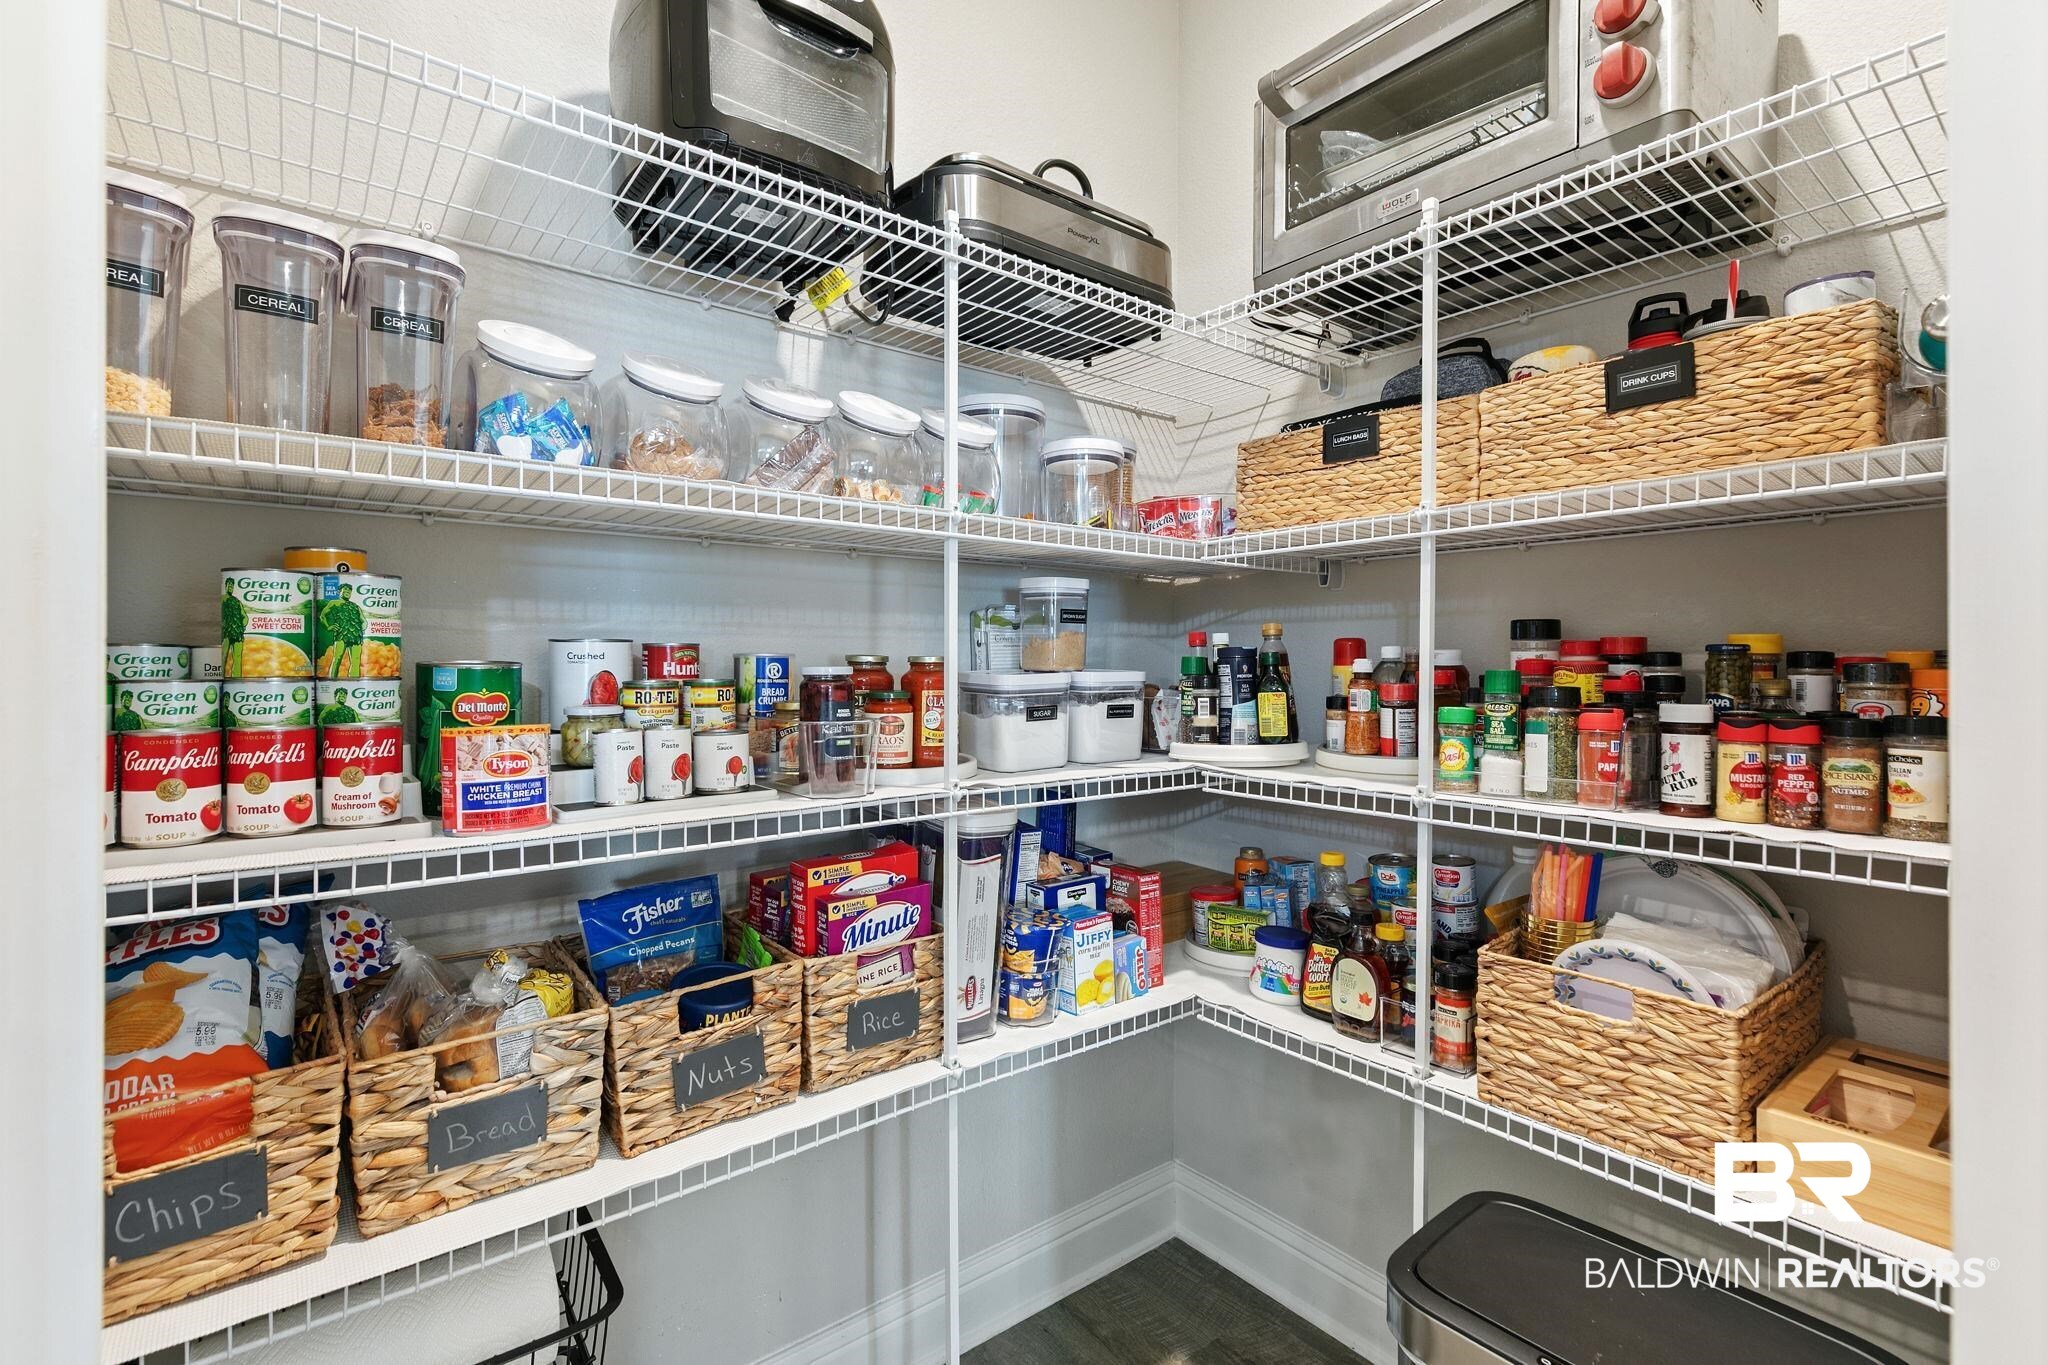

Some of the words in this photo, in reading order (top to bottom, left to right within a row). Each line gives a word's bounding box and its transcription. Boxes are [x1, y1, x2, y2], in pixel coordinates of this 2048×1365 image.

[1383, 193, 1412, 211] WOLF
[1067, 227, 1100, 245] PowerXL
[106, 267, 149, 286] REAL
[247, 294, 306, 315] CEREAL
[383, 316, 433, 334] CEREAL
[1622, 375, 1649, 388] DRINK
[1650, 370, 1676, 382] CUPS
[1334, 435, 1352, 444] LUNCH
[1352, 432, 1368, 440] BAGS
[237, 577, 290, 589] Green
[243, 590, 292, 602] Giant
[356, 584, 398, 596] Green
[363, 596, 398, 608] Giant
[114, 653, 171, 666] Green
[567, 652, 605, 661] Crushed
[121, 665, 173, 678] Giant
[204, 663, 222, 672] Dar
[137, 689, 196, 702] Green
[233, 690, 285, 702] Green
[352, 687, 395, 699] Green
[762, 687, 785, 696] BREAD
[358, 699, 396, 711] Giant
[457, 702, 476, 712] Del
[477, 701, 507, 712] Monte
[927, 696, 945, 707] CLA
[1707, 698, 1730, 707] OYA
[144, 702, 198, 716] Giant
[238, 702, 286, 716] Giant
[1033, 710, 1051, 718] SUGAR
[472, 714, 494, 722] Quality
[780, 724, 800, 737] BETTE
[227, 742, 306, 769] Campbell's
[322, 738, 395, 763] Campbell's
[1439, 749, 1465, 765] Dash
[124, 746, 218, 775] Campbell's
[490, 757, 529, 773] Tyson
[1894, 755, 1921, 764] Choice
[1730, 773, 1766, 783] MUSTAR
[1843, 772, 1878, 782] ISLANDS
[470, 785, 501, 793] WHITE
[1670, 777, 1698, 792] RUB
[1778, 779, 1815, 789] PEPPER
[334, 793, 361, 801] Cream
[362, 792, 372, 800] of
[467, 792, 511, 801] CHICKEN
[513, 788, 543, 798] BREAST
[1832, 786, 1869, 796] NUTMEG
[237, 804, 280, 815] Tomato
[331, 802, 376, 810] Mushroom
[145, 811, 197, 824] Tomato
[155, 832, 186, 841] SOUP
[828, 866, 849, 874] SIMPLE
[1380, 872, 1397, 881] Dole
[1112, 884, 1128, 893] FUDGE
[1376, 886, 1405, 895] PINEAPPLE
[846, 900, 865, 908] SIMPLE
[622, 896, 684, 935] Fisher
[843, 906, 920, 953] Minute
[1076, 919, 1096, 929] America's
[1436, 919, 1452, 934] AND
[1077, 929, 1111, 948] JIFFY
[629, 942, 664, 957] Chopped
[665, 937, 695, 950] Pecans
[1078, 947, 1091, 955] corn
[1093, 942, 1111, 951] muffin
[878, 963, 898, 978] RICE
[1309, 971, 1330, 982] wort
[265, 992, 284, 1000] 5.99
[966, 978, 975, 1009] MUELLER'S
[862, 1011, 905, 1035] Rice
[195, 1026, 216, 1036] 5.99
[688, 1055, 753, 1096] Nuts
[105, 1074, 176, 1105] DDAR
[140, 1107, 176, 1120] FLAVORED
[446, 1103, 536, 1154] Bread
[1810, 1115, 1873, 1135] QUART
[187, 1143, 202, 1154] NET
[203, 1136, 215, 1147] WT
[225, 1127, 234, 1136] OZ
[114, 1181, 242, 1243] Chips
